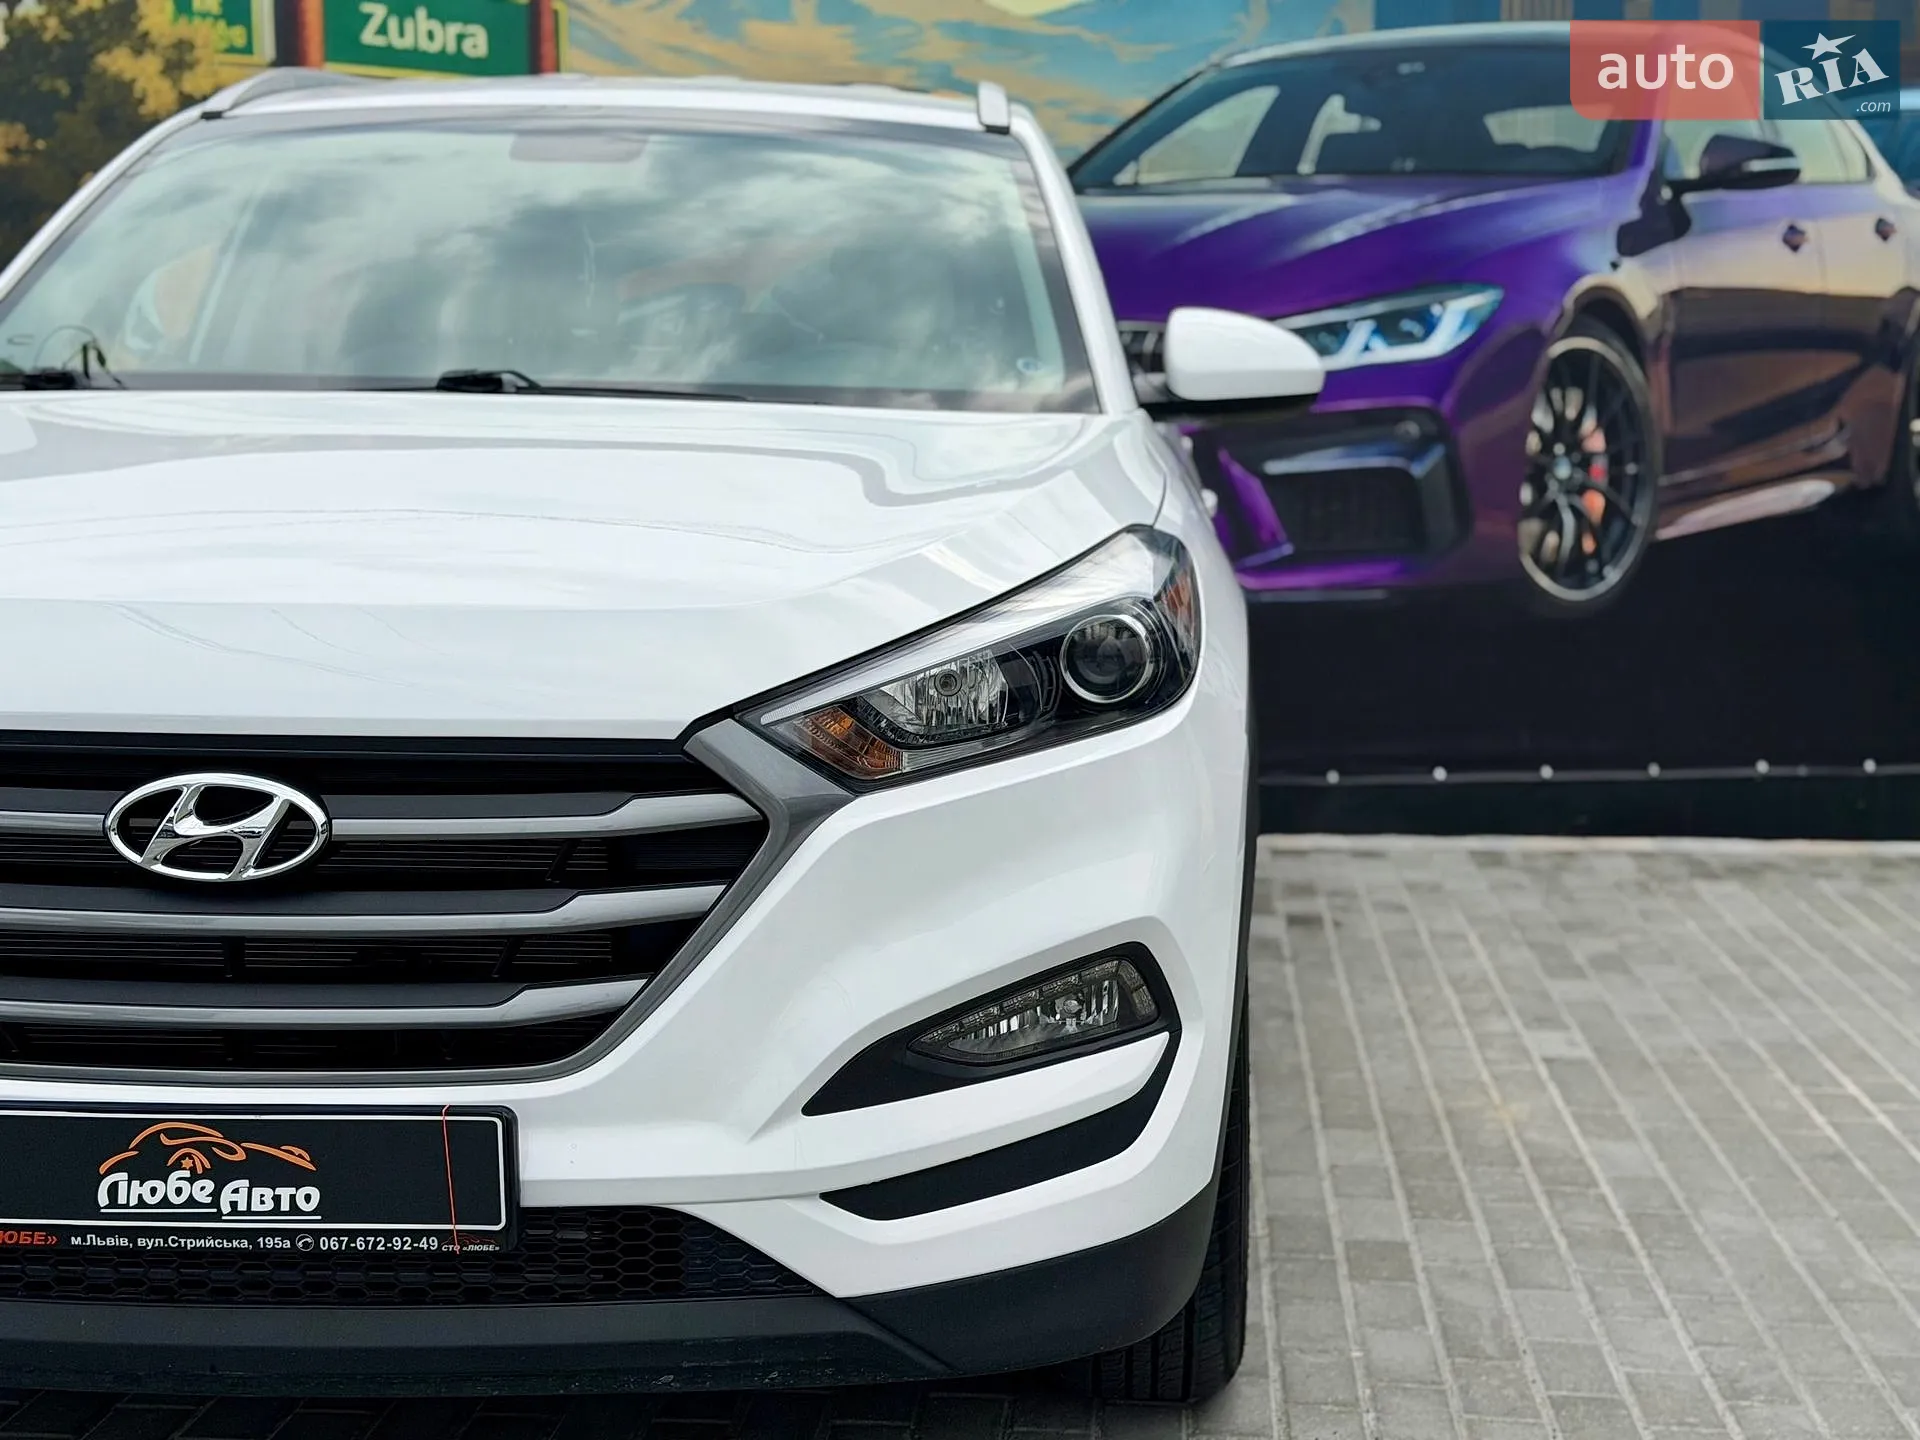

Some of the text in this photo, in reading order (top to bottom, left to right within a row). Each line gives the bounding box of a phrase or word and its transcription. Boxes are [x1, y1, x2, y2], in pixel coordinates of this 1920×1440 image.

[359, 2, 489, 59] Zubra
[98, 1170, 321, 1215] Любе Авто
[137, 1235, 253, 1251] вул.Стрийська,
[319, 1236, 439, 1251] 067-672-92-49
